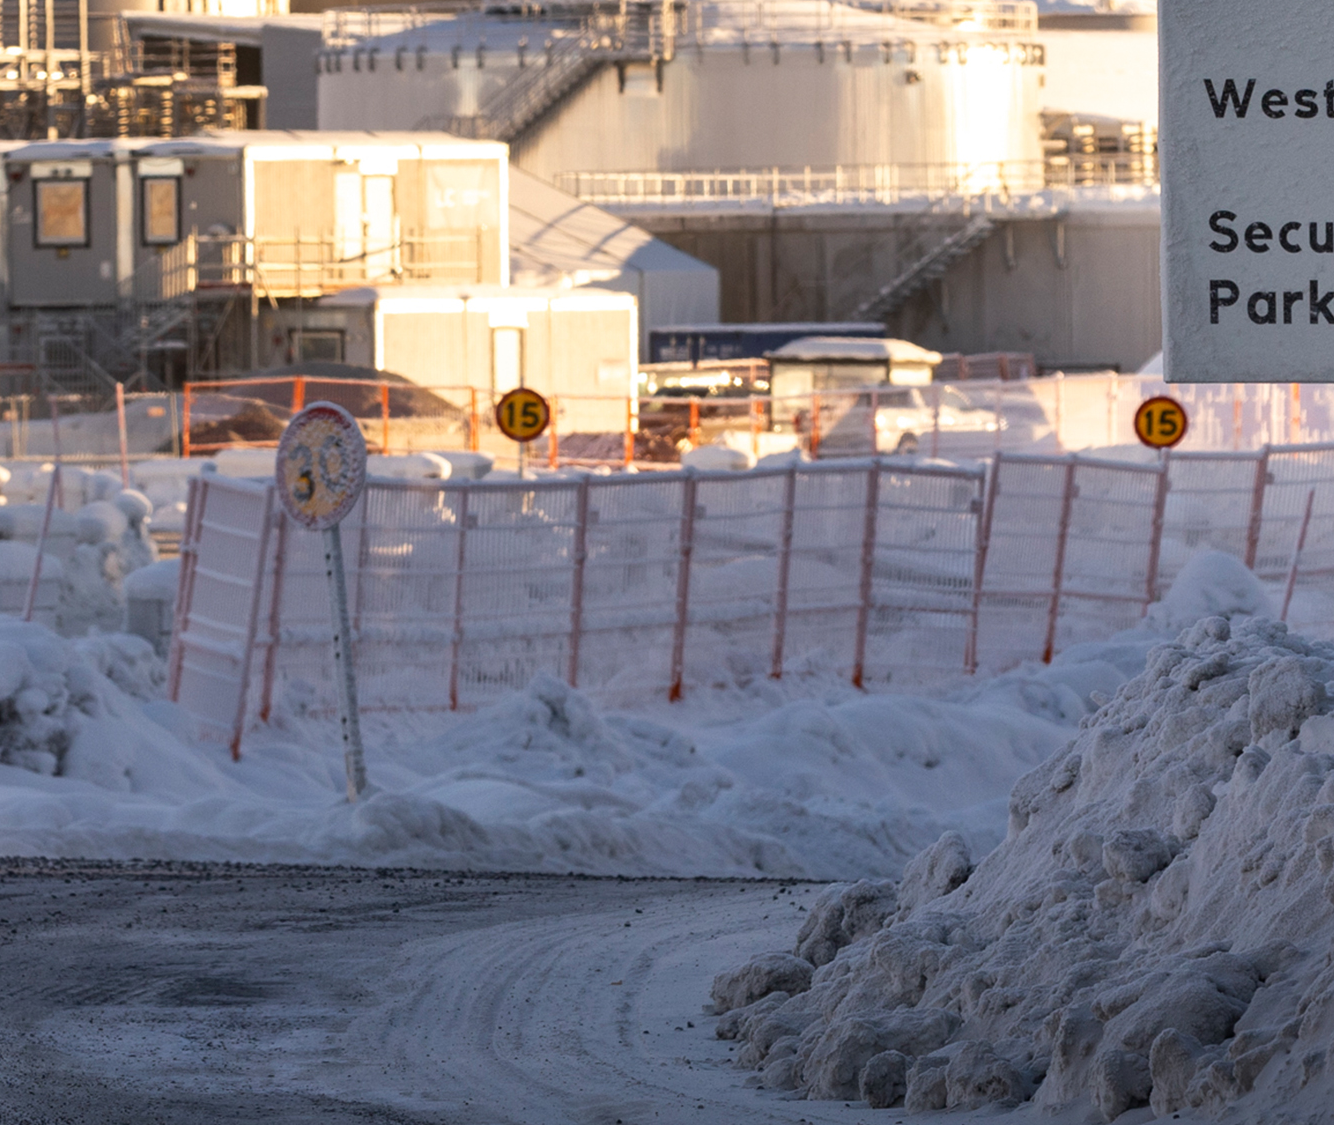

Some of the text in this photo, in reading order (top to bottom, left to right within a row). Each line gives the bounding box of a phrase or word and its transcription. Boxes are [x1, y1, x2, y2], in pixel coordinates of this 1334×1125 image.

[507, 401, 540, 428] 15
[1145, 410, 1178, 437] 15
[288, 434, 350, 503] 30
